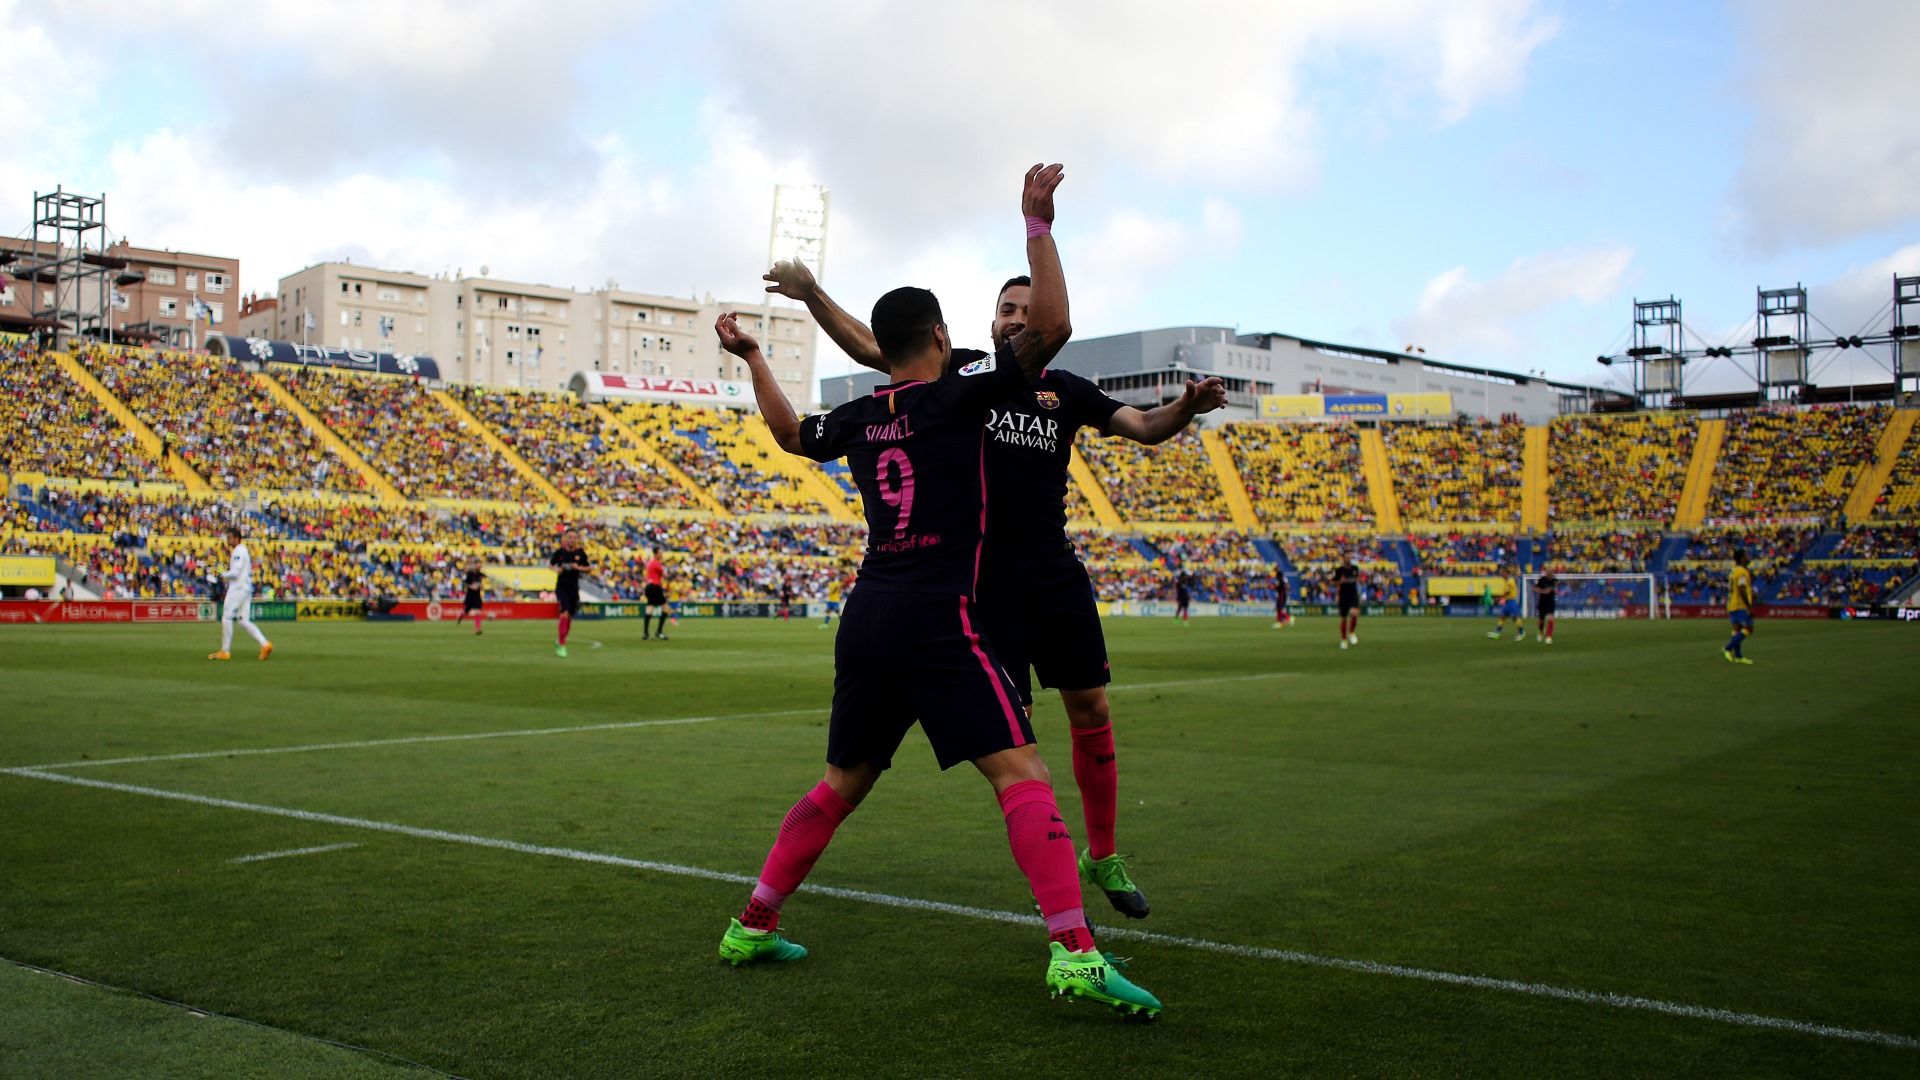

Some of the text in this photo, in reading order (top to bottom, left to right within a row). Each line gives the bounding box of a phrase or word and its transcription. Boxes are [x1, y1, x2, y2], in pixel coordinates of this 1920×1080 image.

[622, 375, 717, 394] SPAR
[994, 429, 1057, 453] AIRWAYS
[876, 447, 915, 540] 9
[147, 606, 196, 618] SPAR
[1076, 969, 1108, 993] adidas
